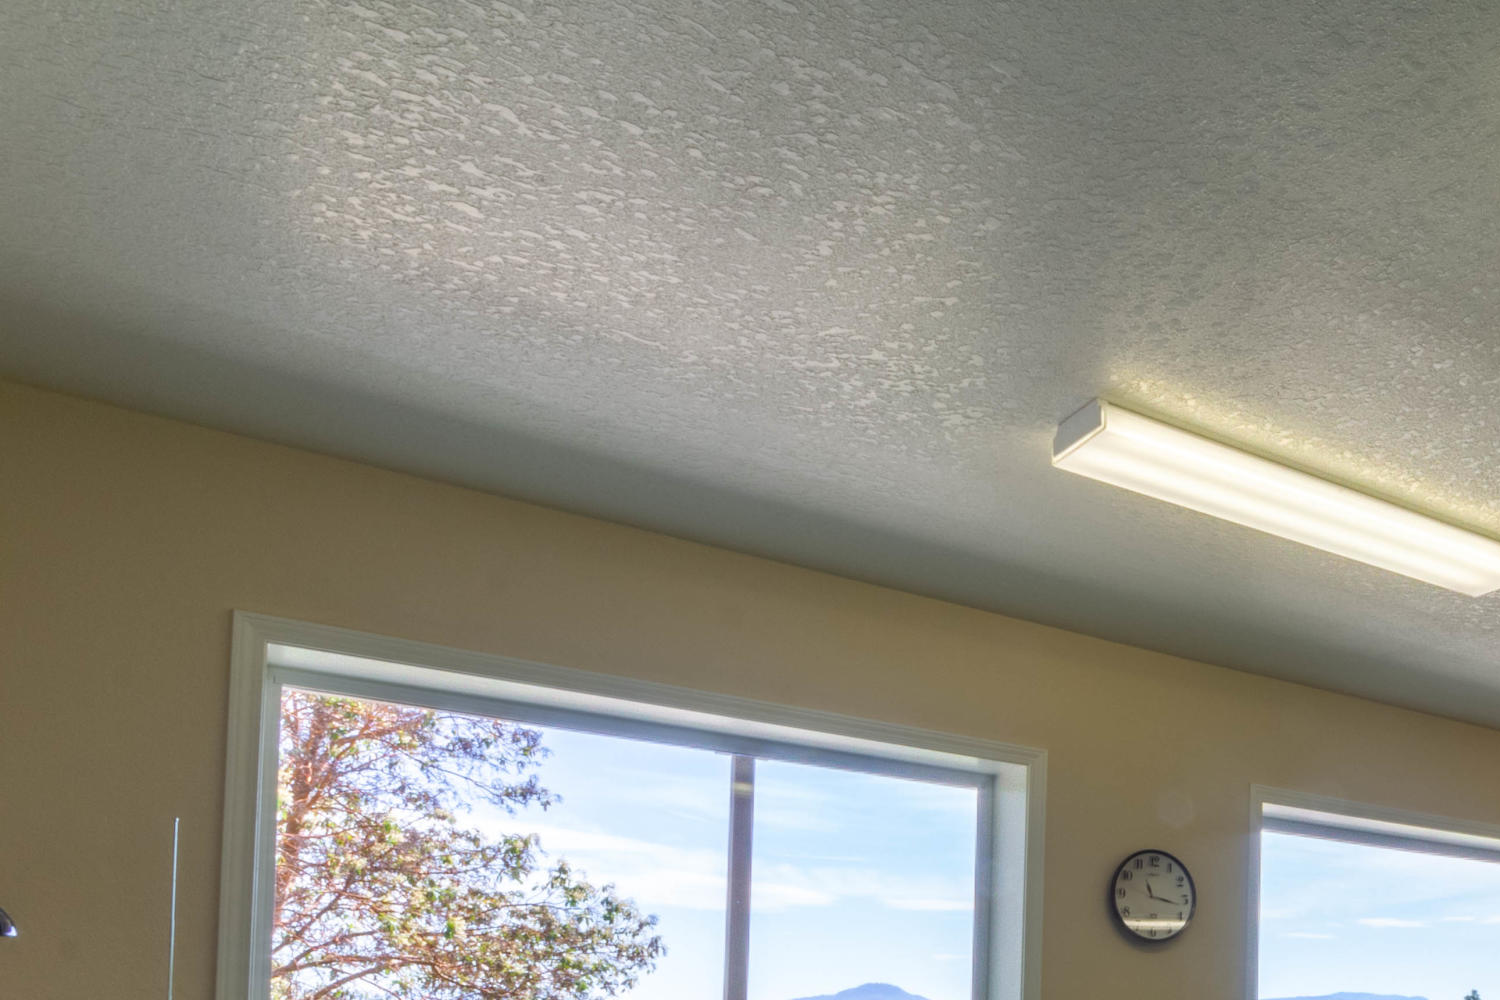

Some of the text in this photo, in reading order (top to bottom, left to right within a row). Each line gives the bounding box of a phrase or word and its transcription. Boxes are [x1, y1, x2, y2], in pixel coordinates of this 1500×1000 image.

[1135, 858, 1143, 870] 11
[1149, 855, 1160, 868] 12
[1167, 863, 1172, 873] 1
[1122, 870, 1133, 881] 10
[1176, 876, 1184, 888] 2
[1119, 888, 1126, 899] 9
[1123, 906, 1130, 917] 8
